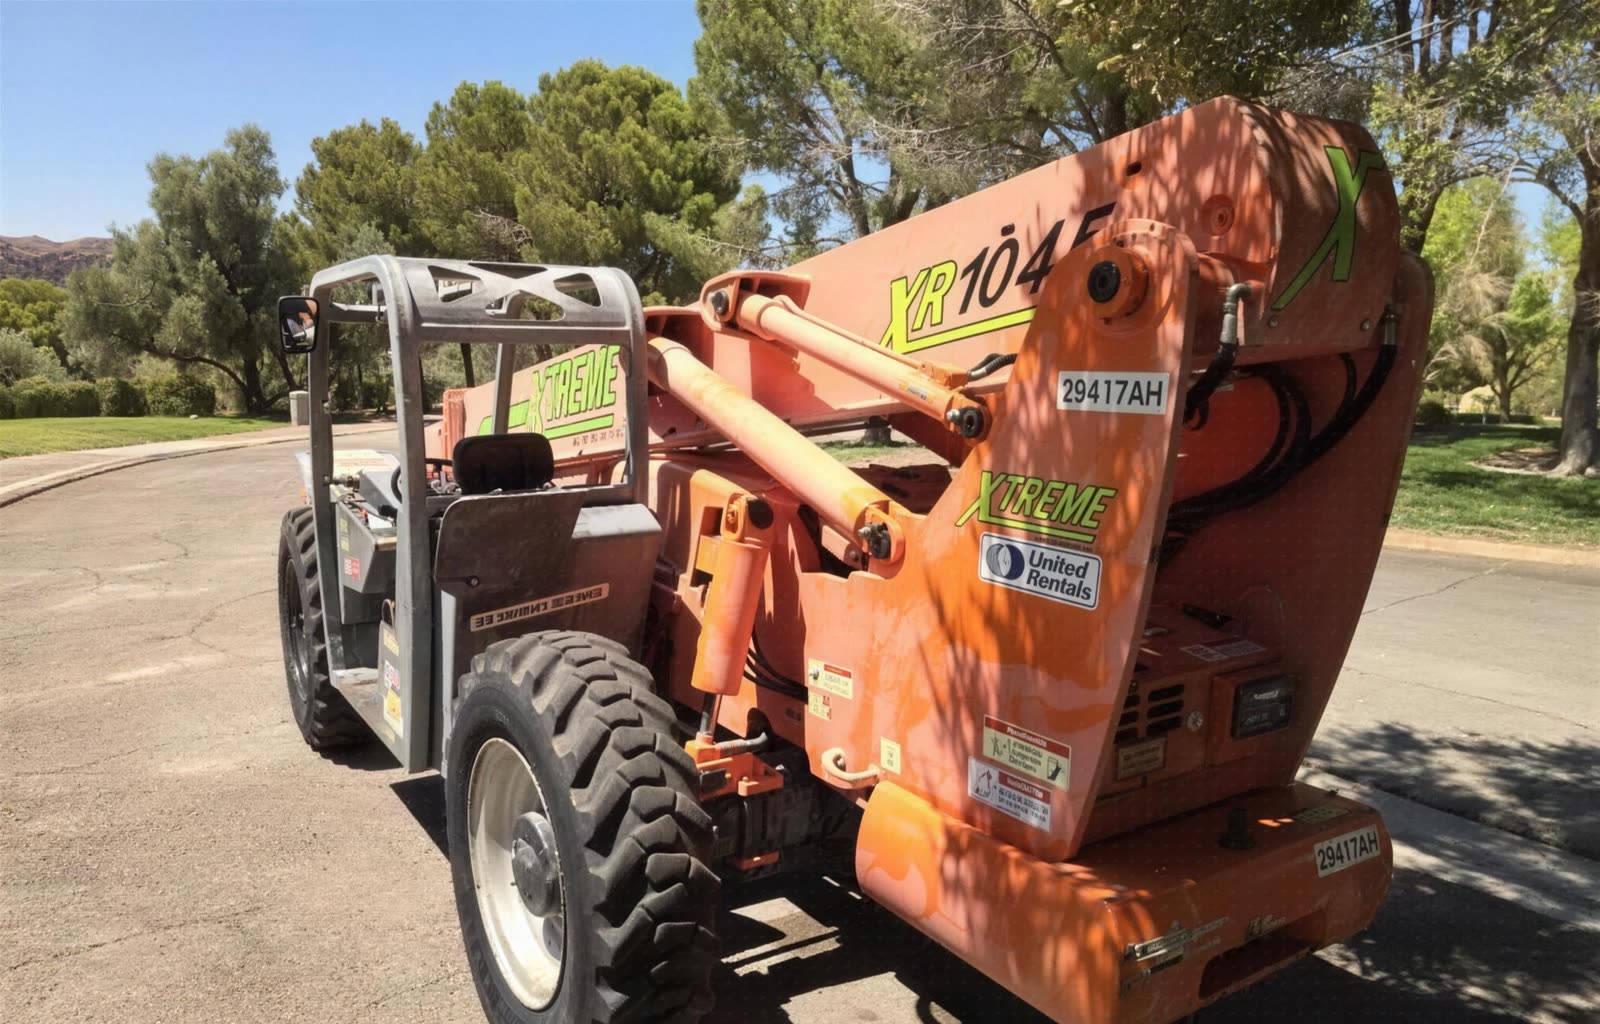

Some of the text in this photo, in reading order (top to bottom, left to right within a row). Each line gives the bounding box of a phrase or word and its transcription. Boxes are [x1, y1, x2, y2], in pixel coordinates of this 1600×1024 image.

[1062, 378, 1163, 407] 29417AH
[955, 470, 1119, 532] XTREME
[1028, 549, 1090, 579] United
[1026, 568, 1093, 602] Rentals
[1316, 830, 1380, 871] 29417AH
